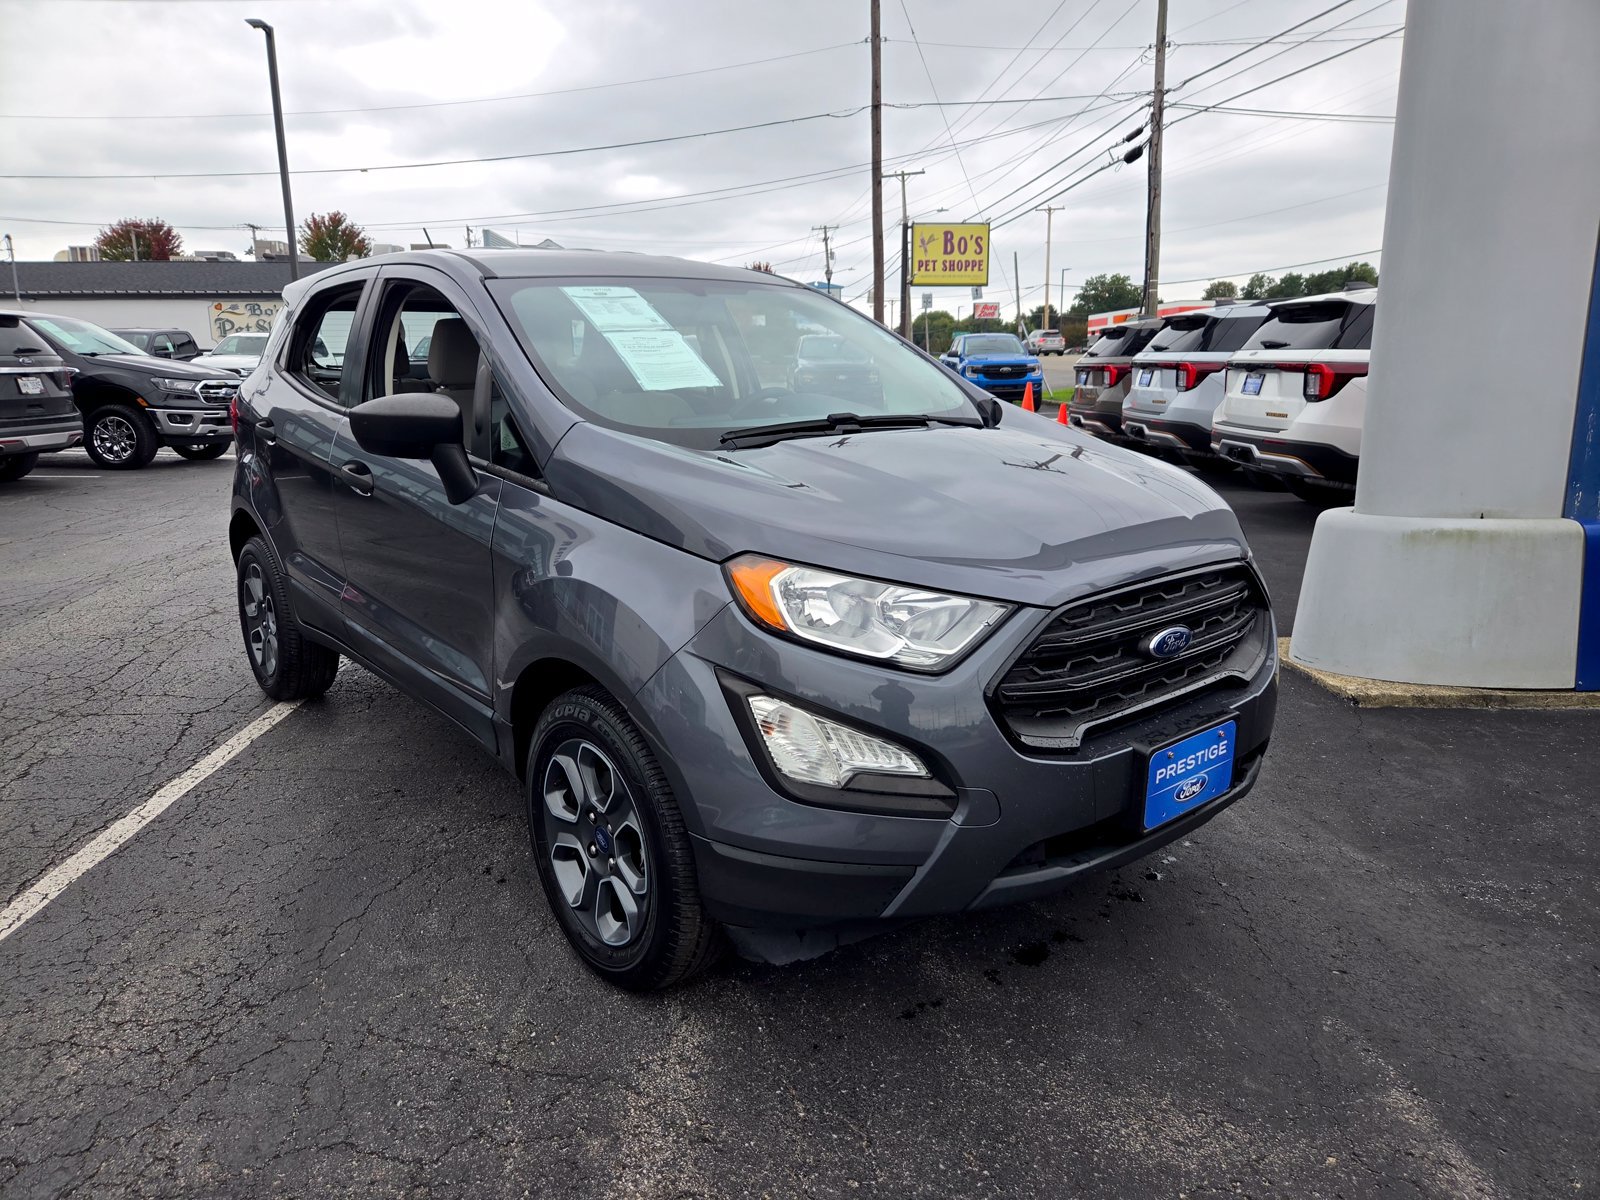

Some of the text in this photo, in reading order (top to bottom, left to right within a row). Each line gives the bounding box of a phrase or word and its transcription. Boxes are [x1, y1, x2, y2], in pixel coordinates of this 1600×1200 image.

[917, 259, 984, 272] PET SHOPPE
[1163, 632, 1186, 652] Ford
[1156, 740, 1228, 784] PRESTIGE
[1180, 778, 1202, 799] Ford
